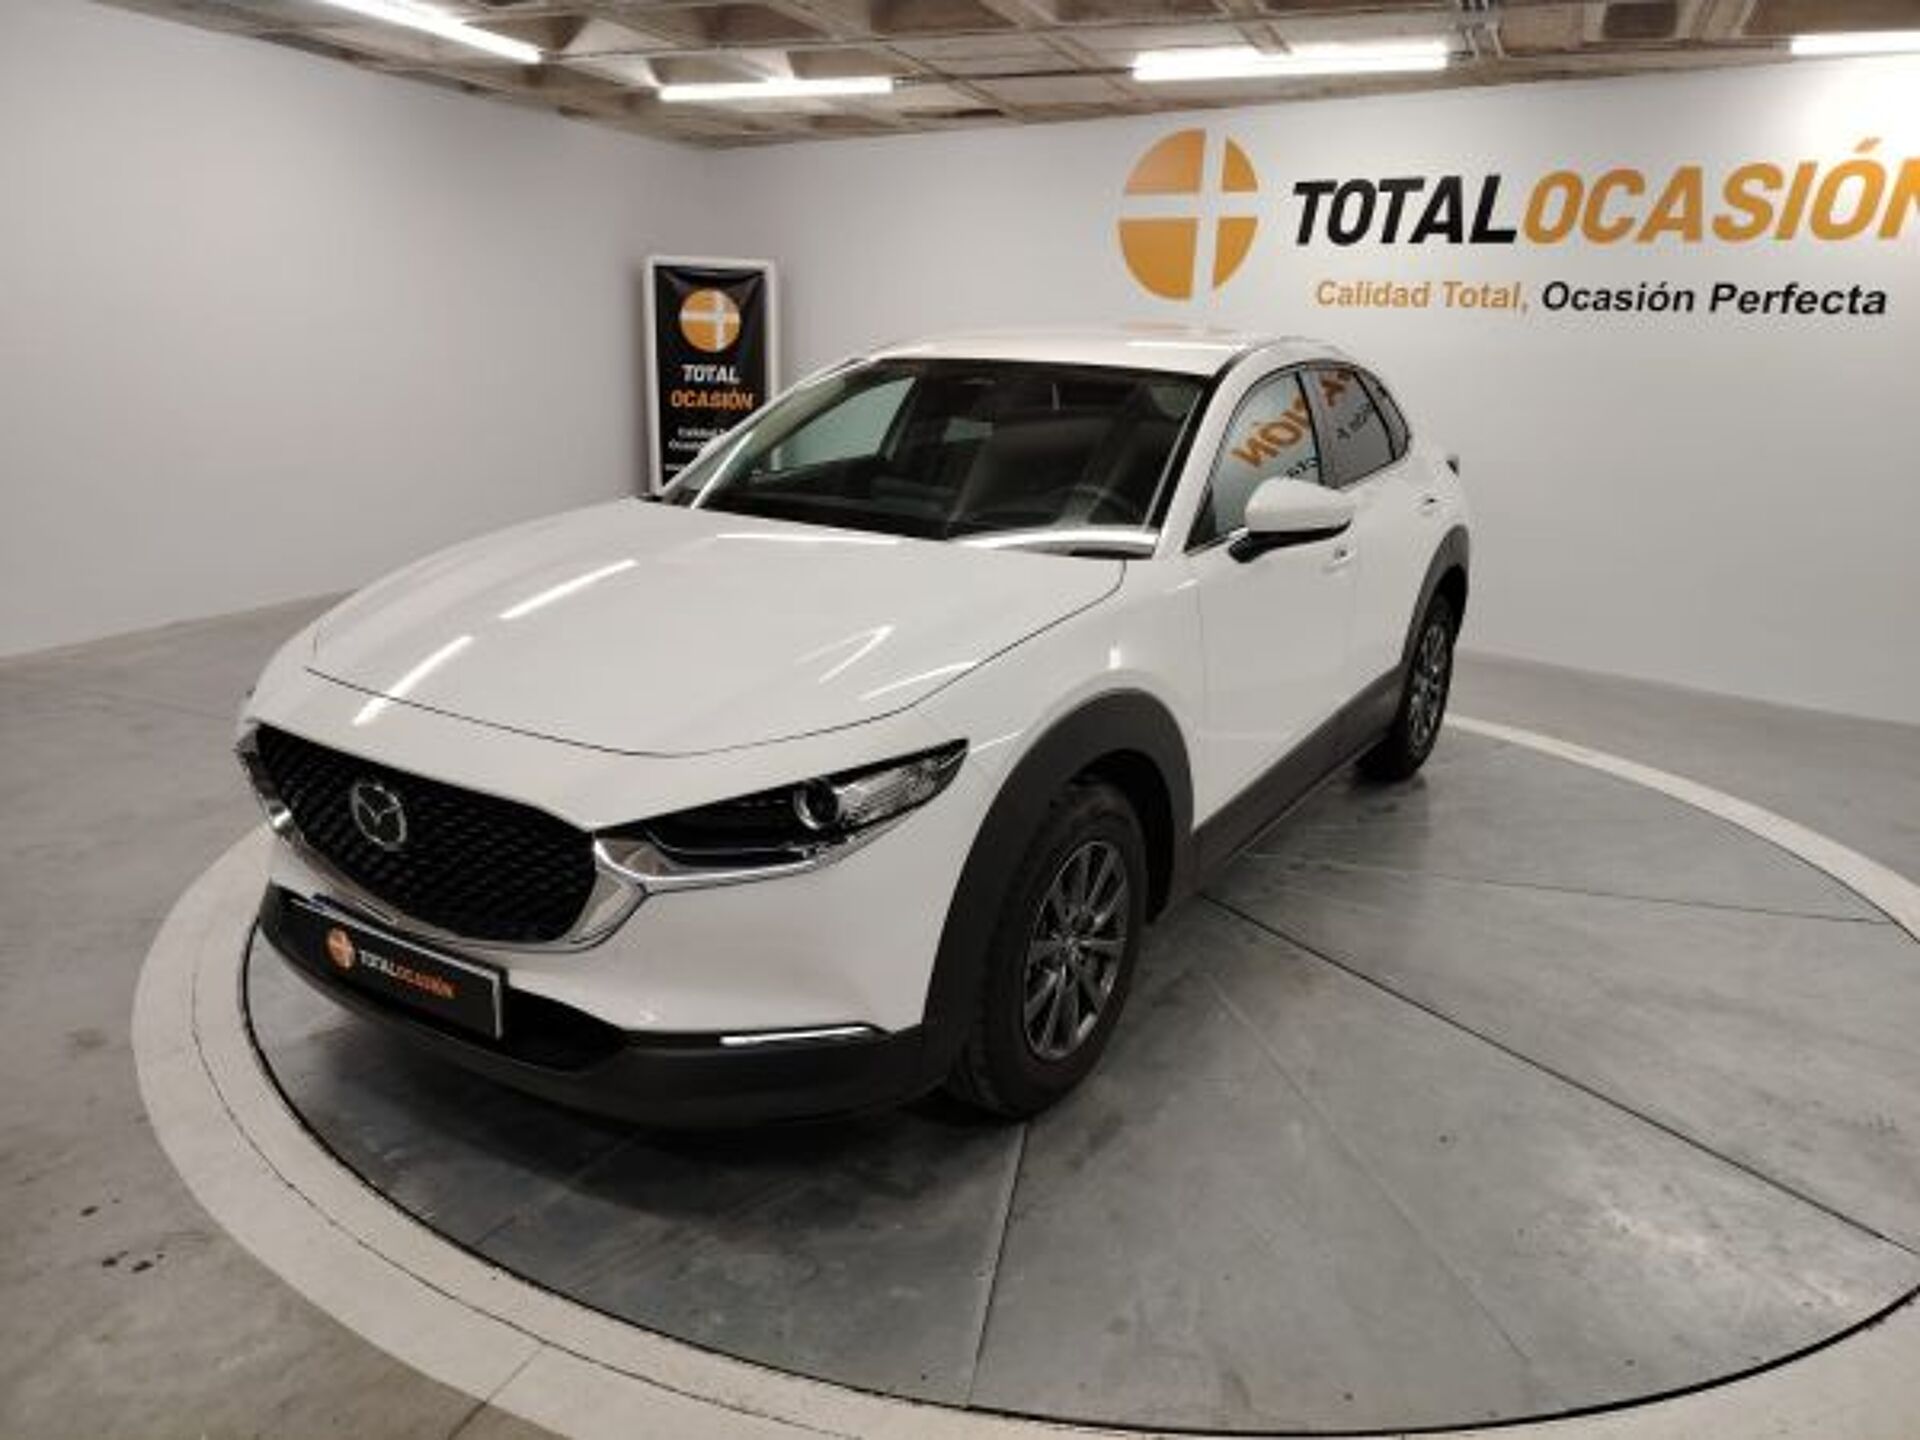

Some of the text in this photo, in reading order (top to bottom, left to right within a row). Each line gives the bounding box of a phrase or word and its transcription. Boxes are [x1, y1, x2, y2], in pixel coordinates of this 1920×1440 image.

[1316, 280, 1887, 315] Calidad Total, Ocasión Perfecta
[681, 364, 740, 384] TOTAL
[671, 387, 754, 410] OCASIÓN
